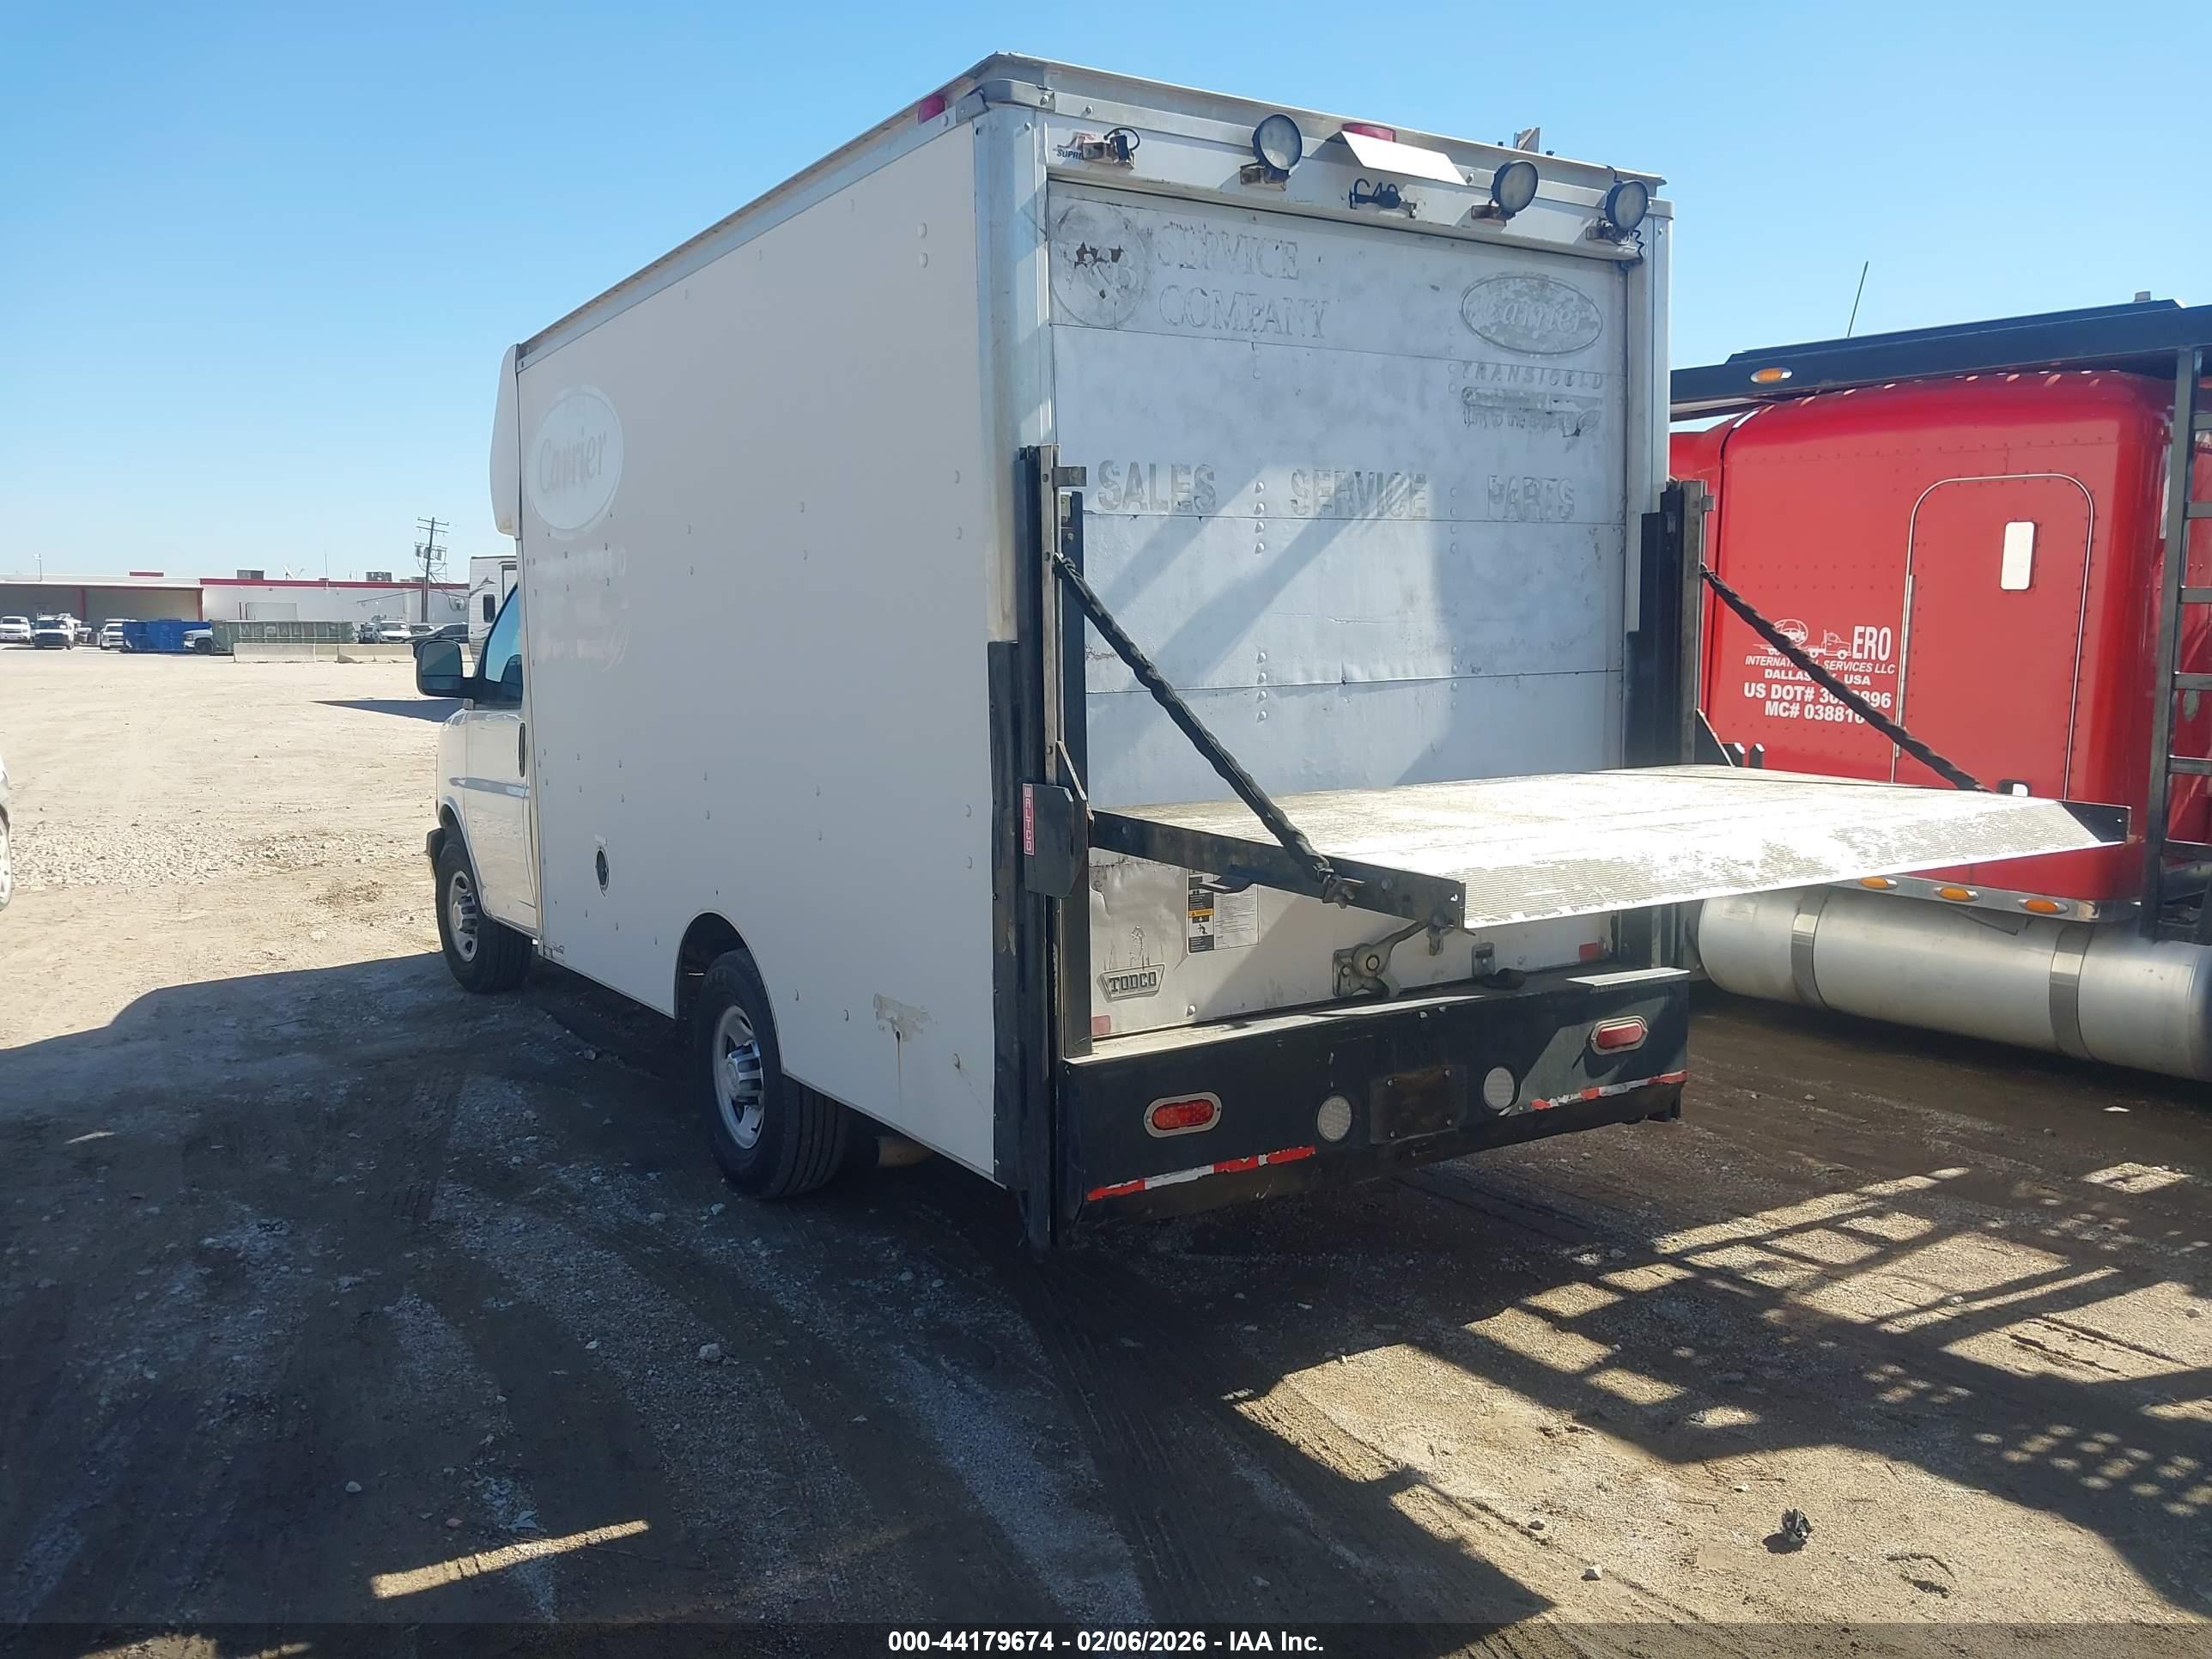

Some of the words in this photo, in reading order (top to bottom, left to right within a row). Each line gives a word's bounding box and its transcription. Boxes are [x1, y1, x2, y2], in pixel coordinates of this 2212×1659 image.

[1158, 284, 1329, 338] COMPANY
[538, 426, 607, 496] Carrier
[1097, 459, 1217, 514] SALES
[1290, 467, 1429, 518] SERVICE
[1852, 625, 1892, 661] ERO
[1824, 659, 1873, 672] SERVICES
[1875, 663, 1896, 674] LLC
[1844, 673, 1871, 686] USA
[1744, 683, 1766, 698] US
[1771, 684, 1815, 702] DOT#
[1765, 701, 1801, 719] MC#
[1108, 971, 1157, 993] TODCO
